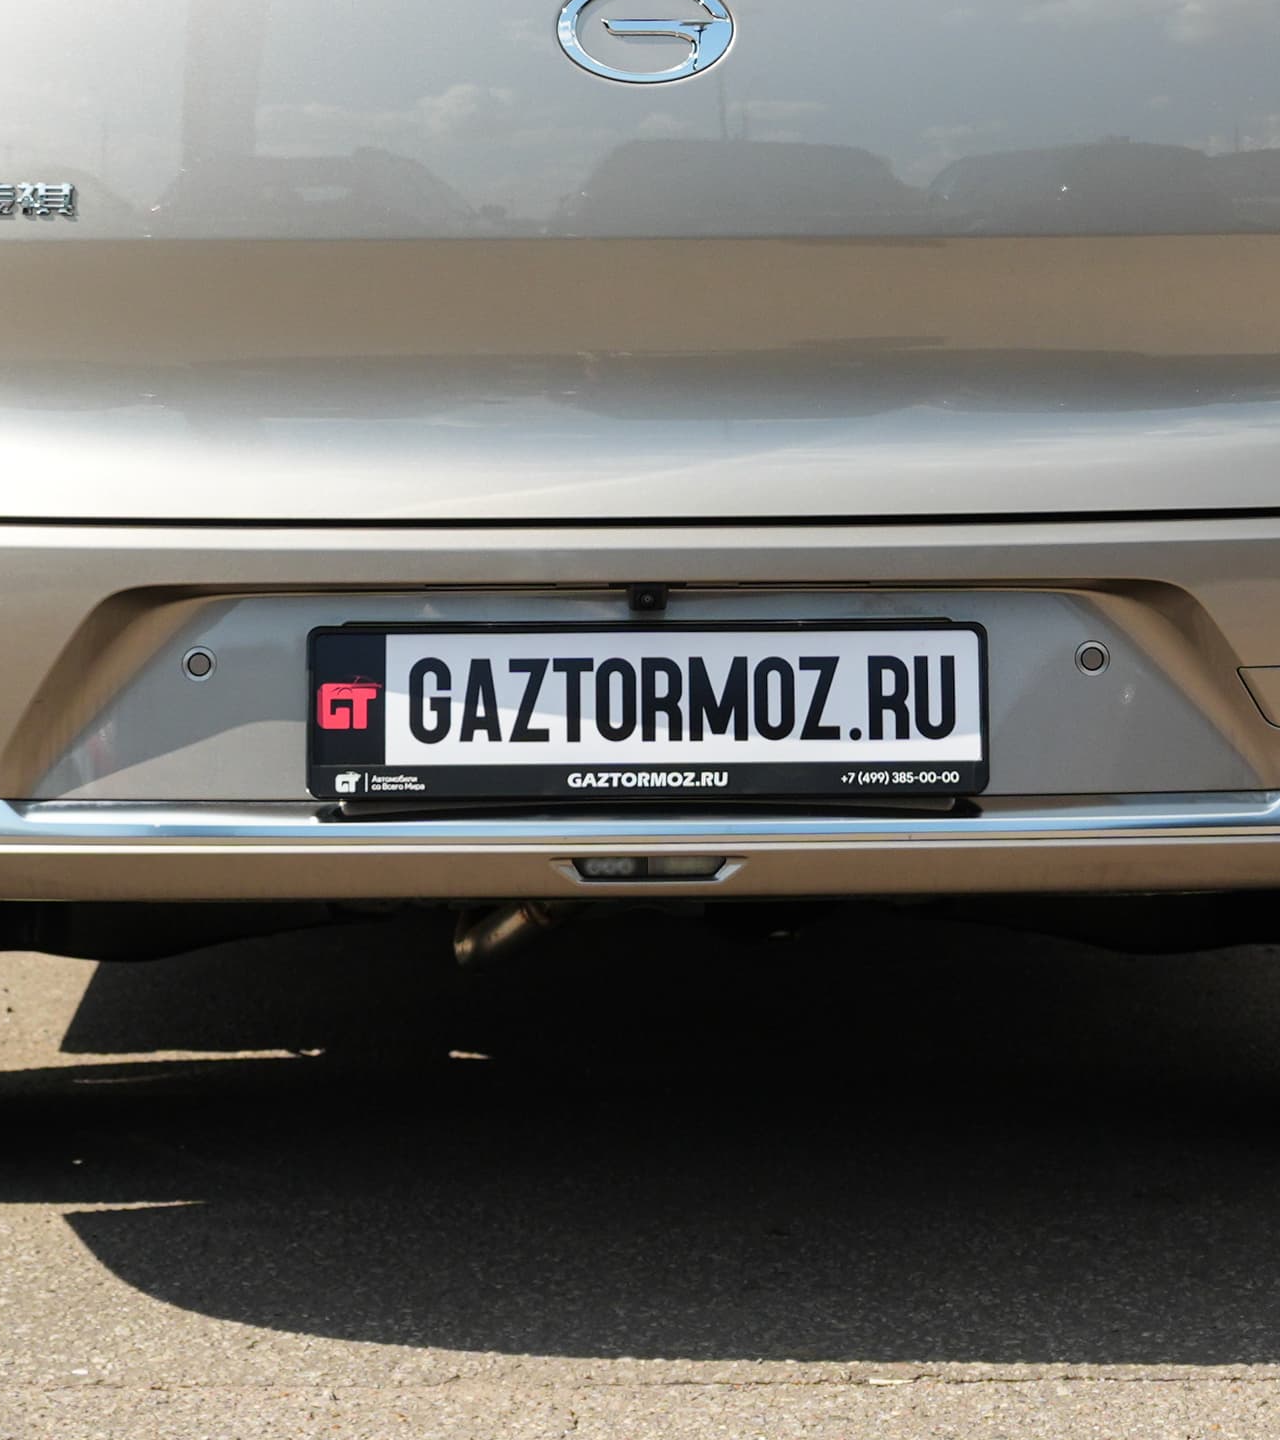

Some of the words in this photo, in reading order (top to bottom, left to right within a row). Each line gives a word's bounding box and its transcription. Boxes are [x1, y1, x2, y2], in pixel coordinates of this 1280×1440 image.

[317, 677, 380, 730] GT
[408, 655, 956, 744] GAZTORMOZ.RU
[335, 771, 361, 793] GT
[567, 772, 728, 788] GAZTORMOZ.RU
[840, 772, 856, 784] +7
[858, 771, 890, 785] (499)
[891, 771, 960, 784] 385-00-00
